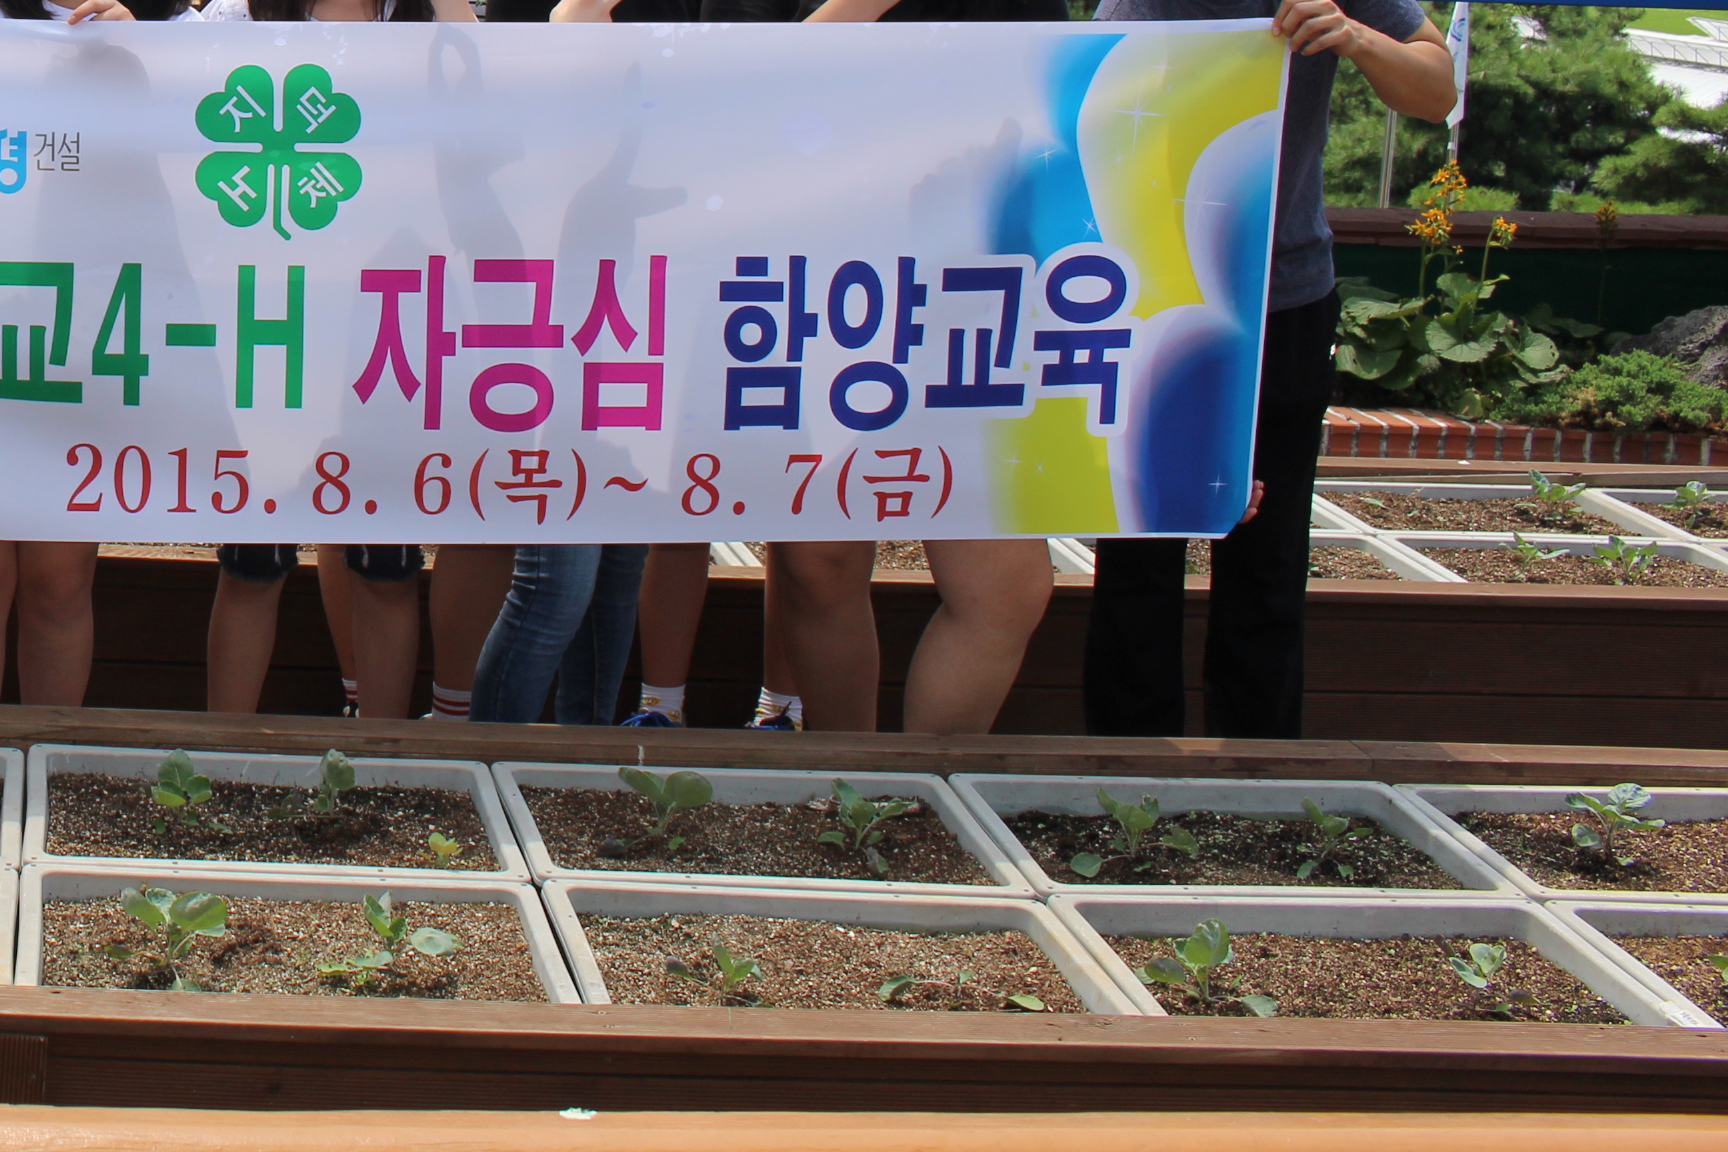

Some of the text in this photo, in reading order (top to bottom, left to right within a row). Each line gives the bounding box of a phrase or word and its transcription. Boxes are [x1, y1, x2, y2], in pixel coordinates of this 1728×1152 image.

[219, 85, 337, 134] 지 덕
[33, 132, 81, 172] 건설
[217, 161, 345, 212] 노 체
[352, 255, 668, 431] 자긍심
[719, 255, 1132, 432] 함양교육
[66, 443, 278, 515] 2015.
[783, 446, 954, 521] 7(금)
